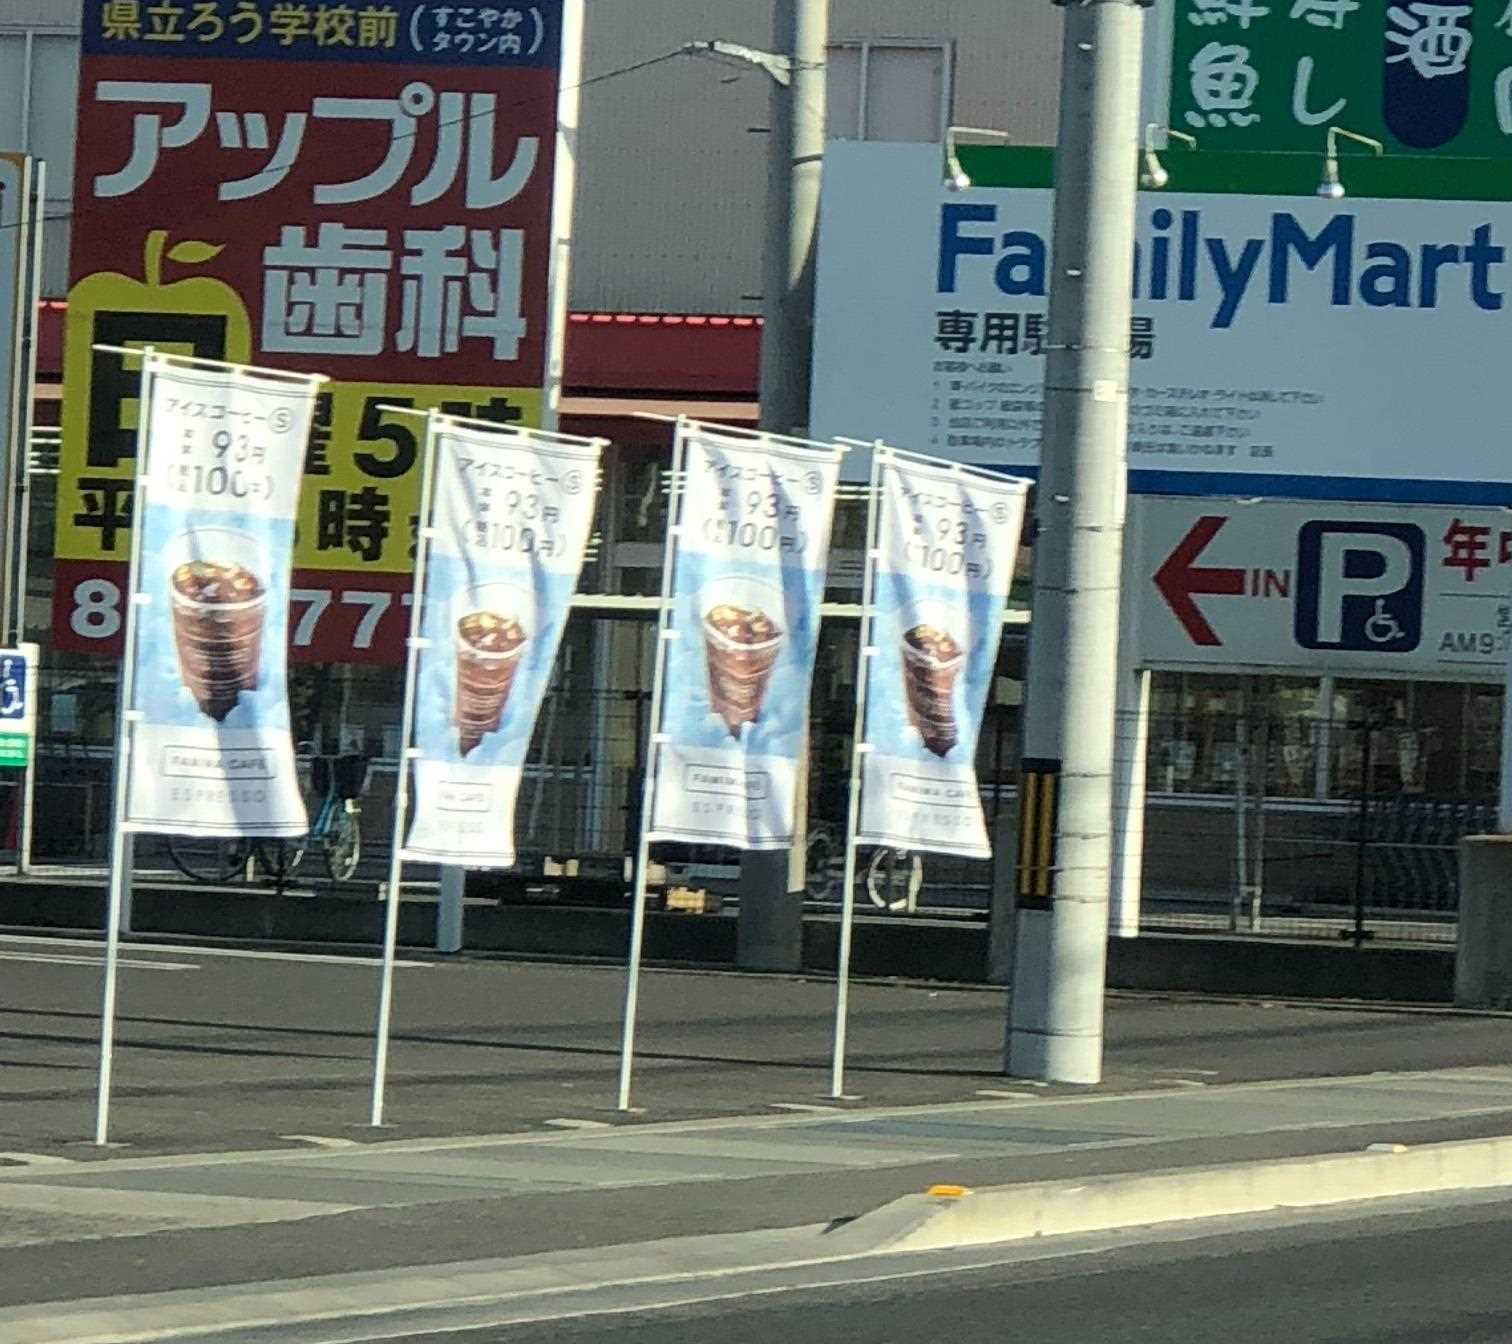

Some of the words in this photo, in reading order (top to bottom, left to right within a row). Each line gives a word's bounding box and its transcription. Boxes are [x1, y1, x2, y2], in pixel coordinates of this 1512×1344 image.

[102, 0, 399, 48] 県立ろう学校前
[1384, 1, 1474, 79] 酒
[94, 79, 540, 210] アップル
[260, 221, 527, 361] 歯科
[936, 202, 1507, 330] FailyMart
[1250, 567, 1290, 599] IN
